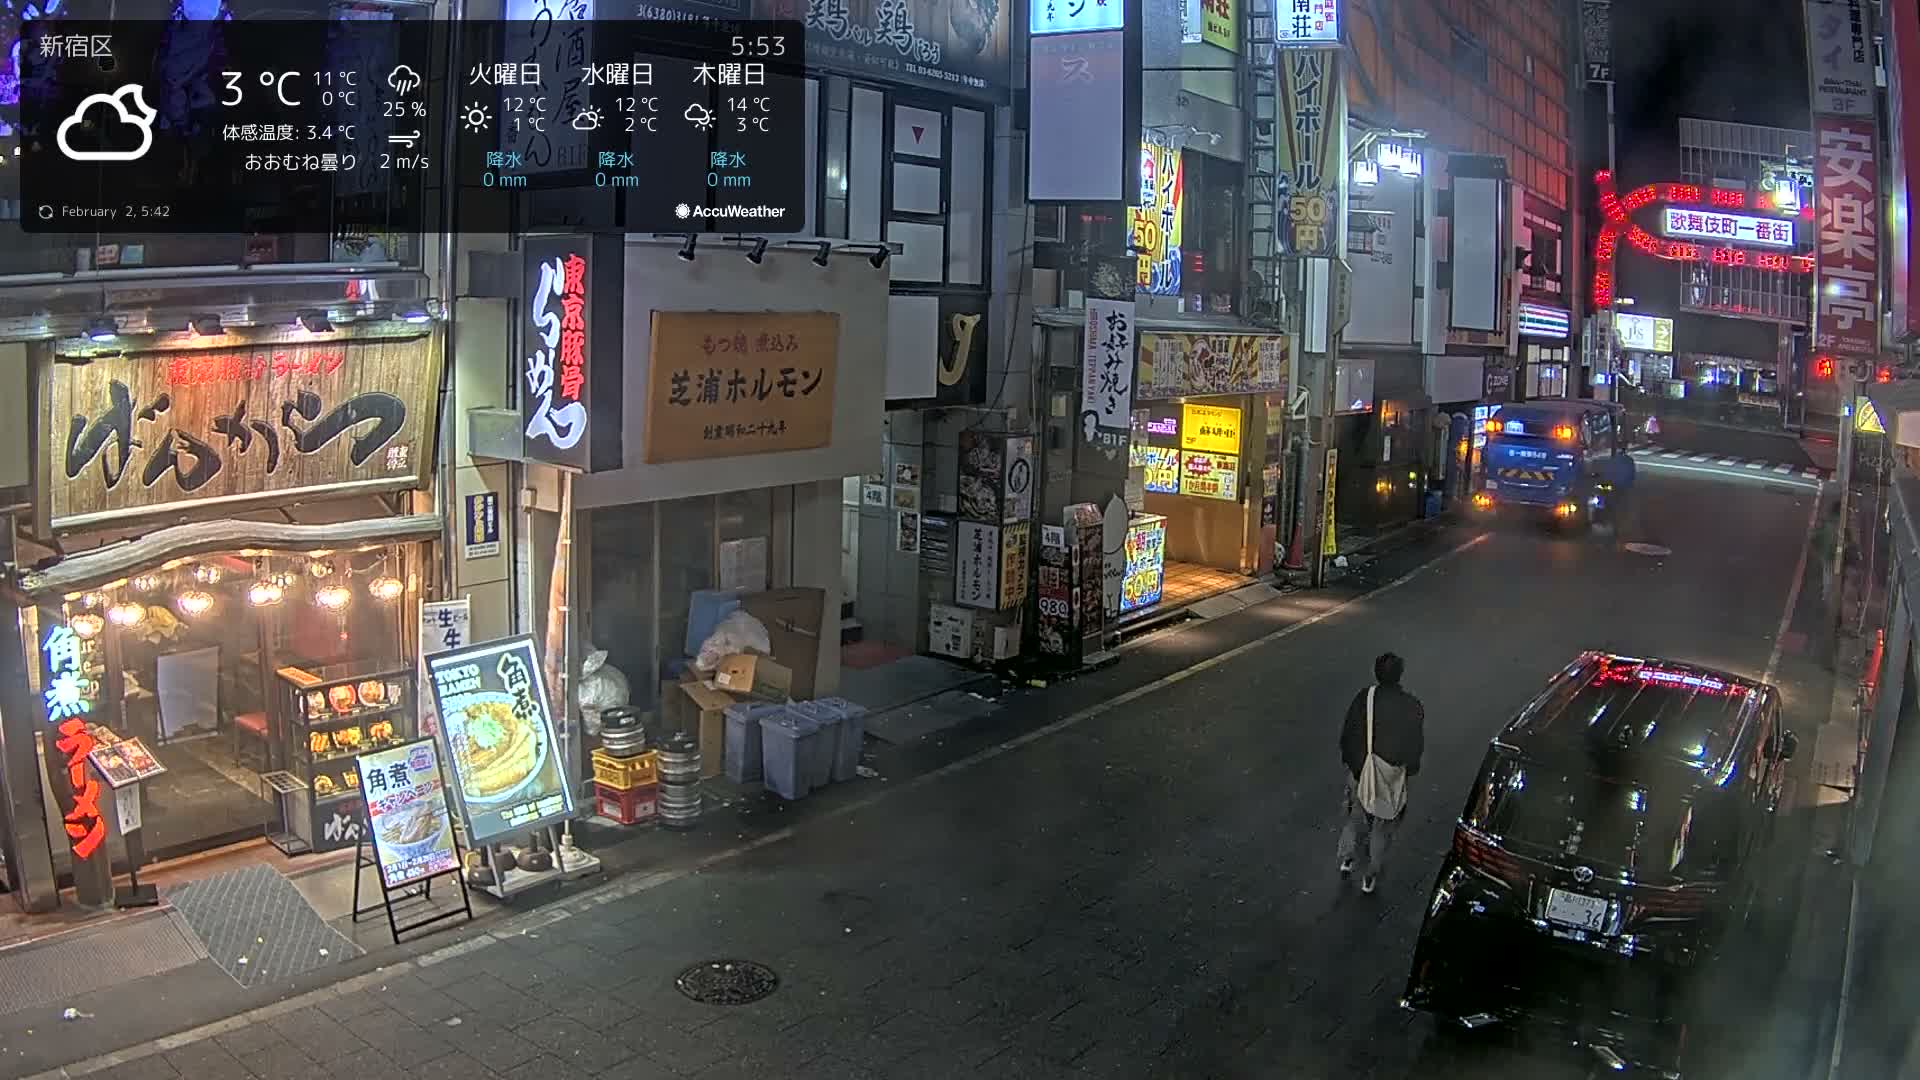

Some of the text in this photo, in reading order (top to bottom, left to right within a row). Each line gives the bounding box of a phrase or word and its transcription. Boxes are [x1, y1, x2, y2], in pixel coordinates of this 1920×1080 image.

[1295, 55, 1321, 190] ハイボール
[1161, 151, 1175, 289] ハイボール
[1670, 212, 1790, 242] 歌舞伎町一番街
[1817, 127, 1874, 330] 安楽亭
[560, 254, 586, 401] 東京豚骨
[1101, 309, 1129, 415] お好み焼き
[66, 379, 407, 493] ばんから
[669, 368, 823, 405] 芝浦ホルモン
[1103, 432, 1128, 446] B1F
[497, 652, 541, 721] 角煮
[367, 762, 411, 793] 角煮
